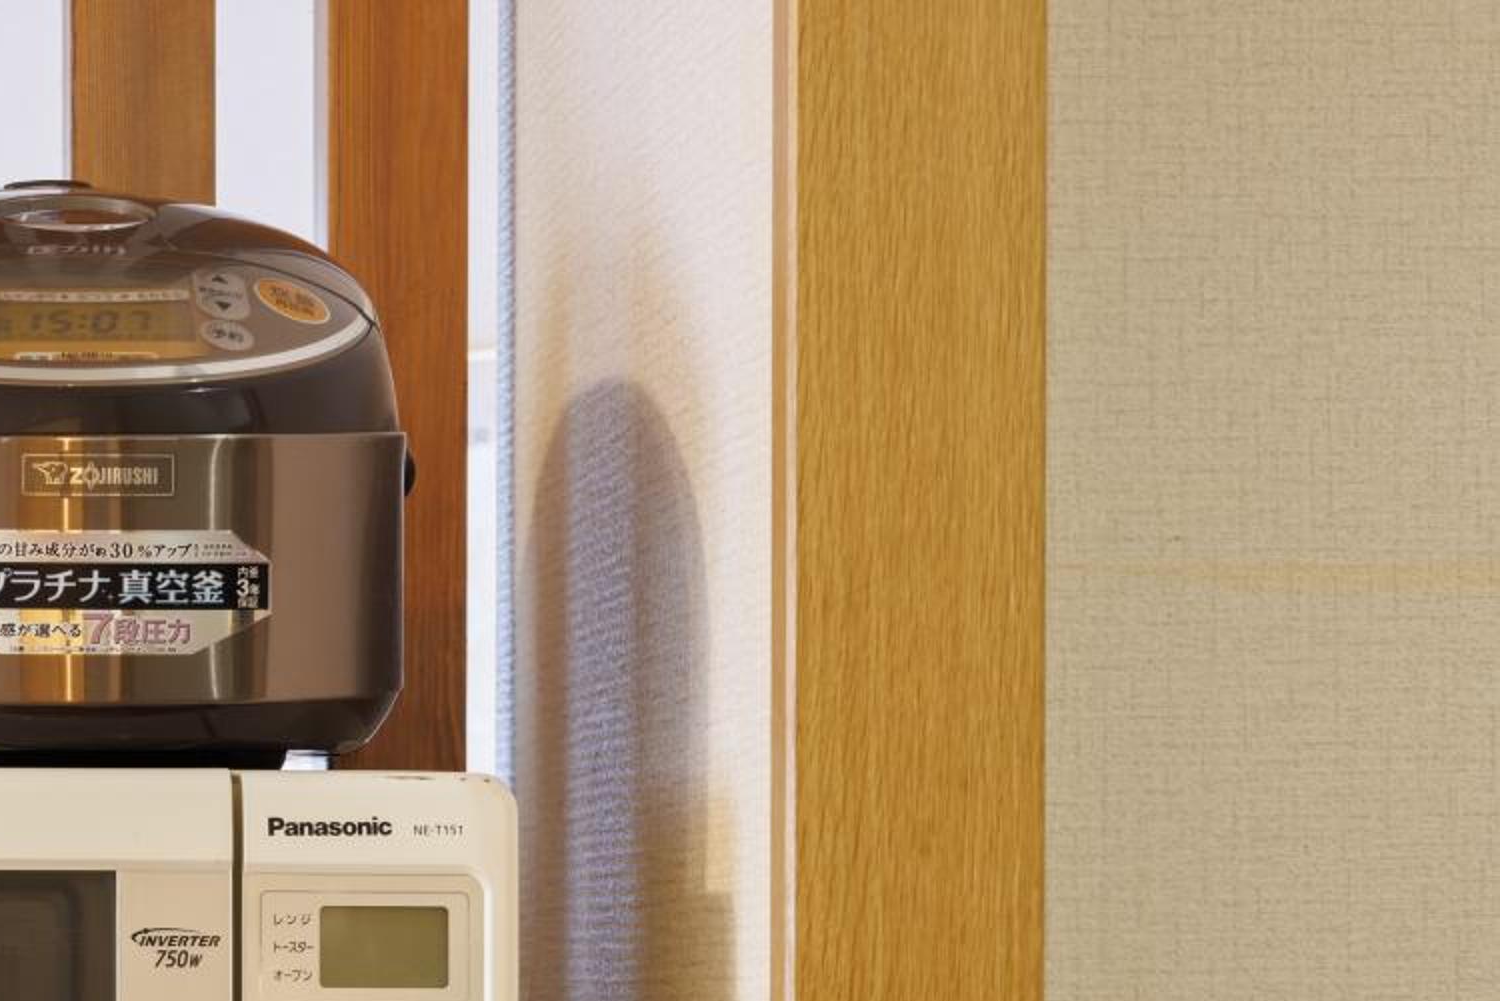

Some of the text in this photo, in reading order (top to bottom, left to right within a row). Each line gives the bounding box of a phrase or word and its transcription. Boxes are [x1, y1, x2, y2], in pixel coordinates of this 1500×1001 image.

[70, 463, 158, 488] ZOJIRUSHI
[118, 569, 225, 604] 真空釜
[267, 816, 464, 837] Panasonic NE-T151
[273, 913, 312, 926] レンジ
[138, 934, 221, 947] INVERTER
[273, 941, 315, 953] トースター
